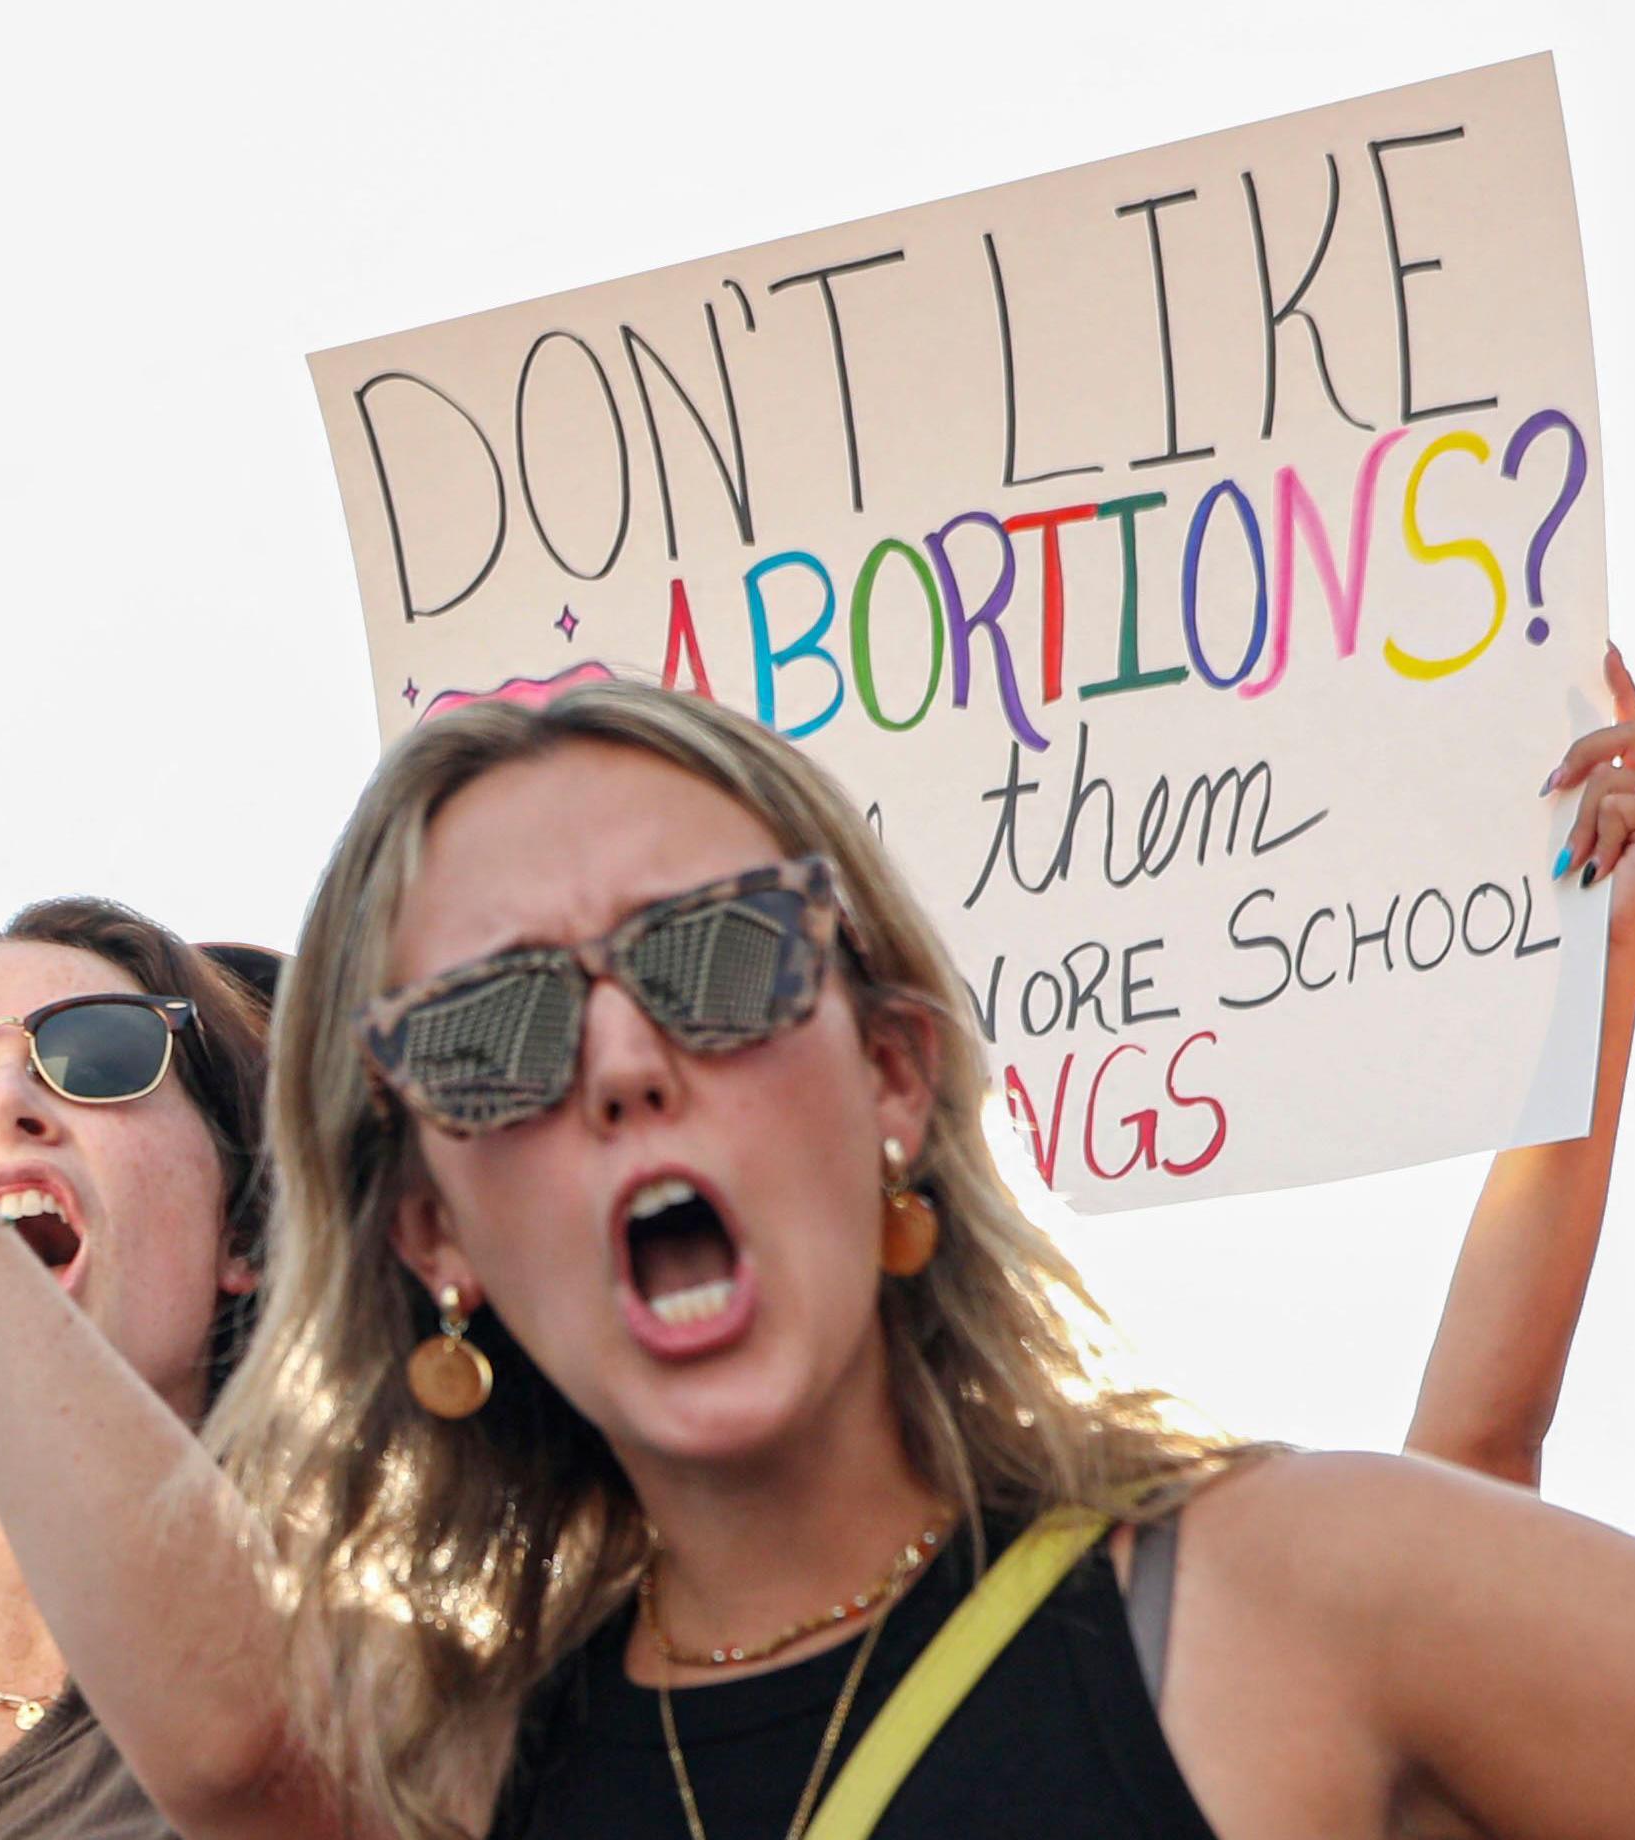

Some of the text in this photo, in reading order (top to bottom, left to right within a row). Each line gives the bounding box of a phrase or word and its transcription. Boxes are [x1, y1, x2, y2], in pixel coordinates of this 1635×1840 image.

[352, 125, 1500, 626] DON'T LIKE
[660, 408, 1588, 752] ABORTIONS?
[962, 722, 1330, 911] them
[1217, 873, 1561, 1011] SCHOOL
